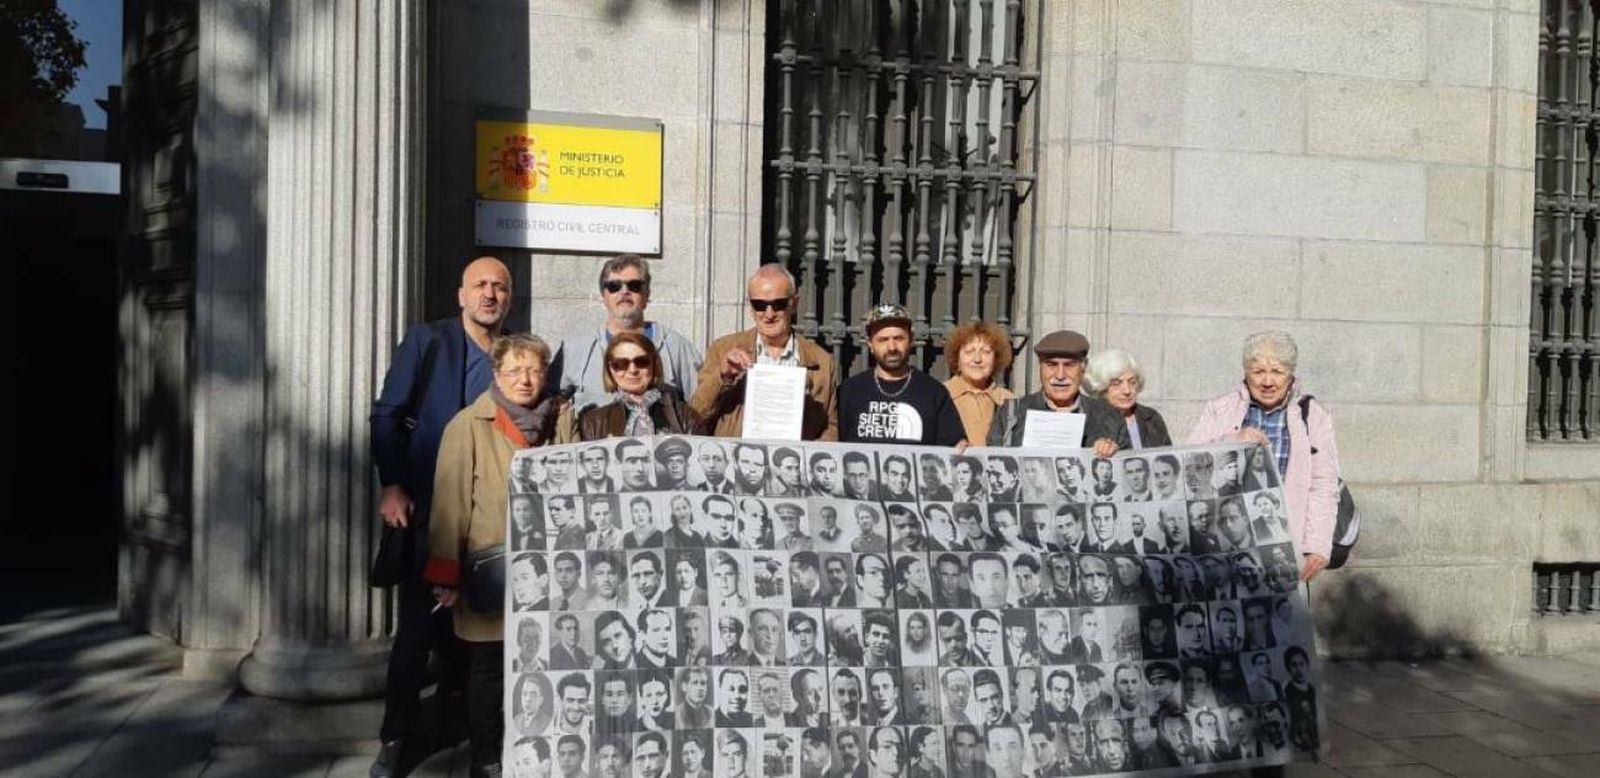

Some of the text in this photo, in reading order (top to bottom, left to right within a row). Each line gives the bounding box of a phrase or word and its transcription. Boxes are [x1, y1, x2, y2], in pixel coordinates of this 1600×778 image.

[559, 151, 624, 164] MINISTERIO
[559, 165, 626, 178] DE JUSTICIA
[496, 217, 641, 236] REGISTRO CIVIL CENTRAL
[869, 401, 897, 414] RPG
[858, 413, 898, 426] SIETE
[857, 425, 897, 438] CREW
